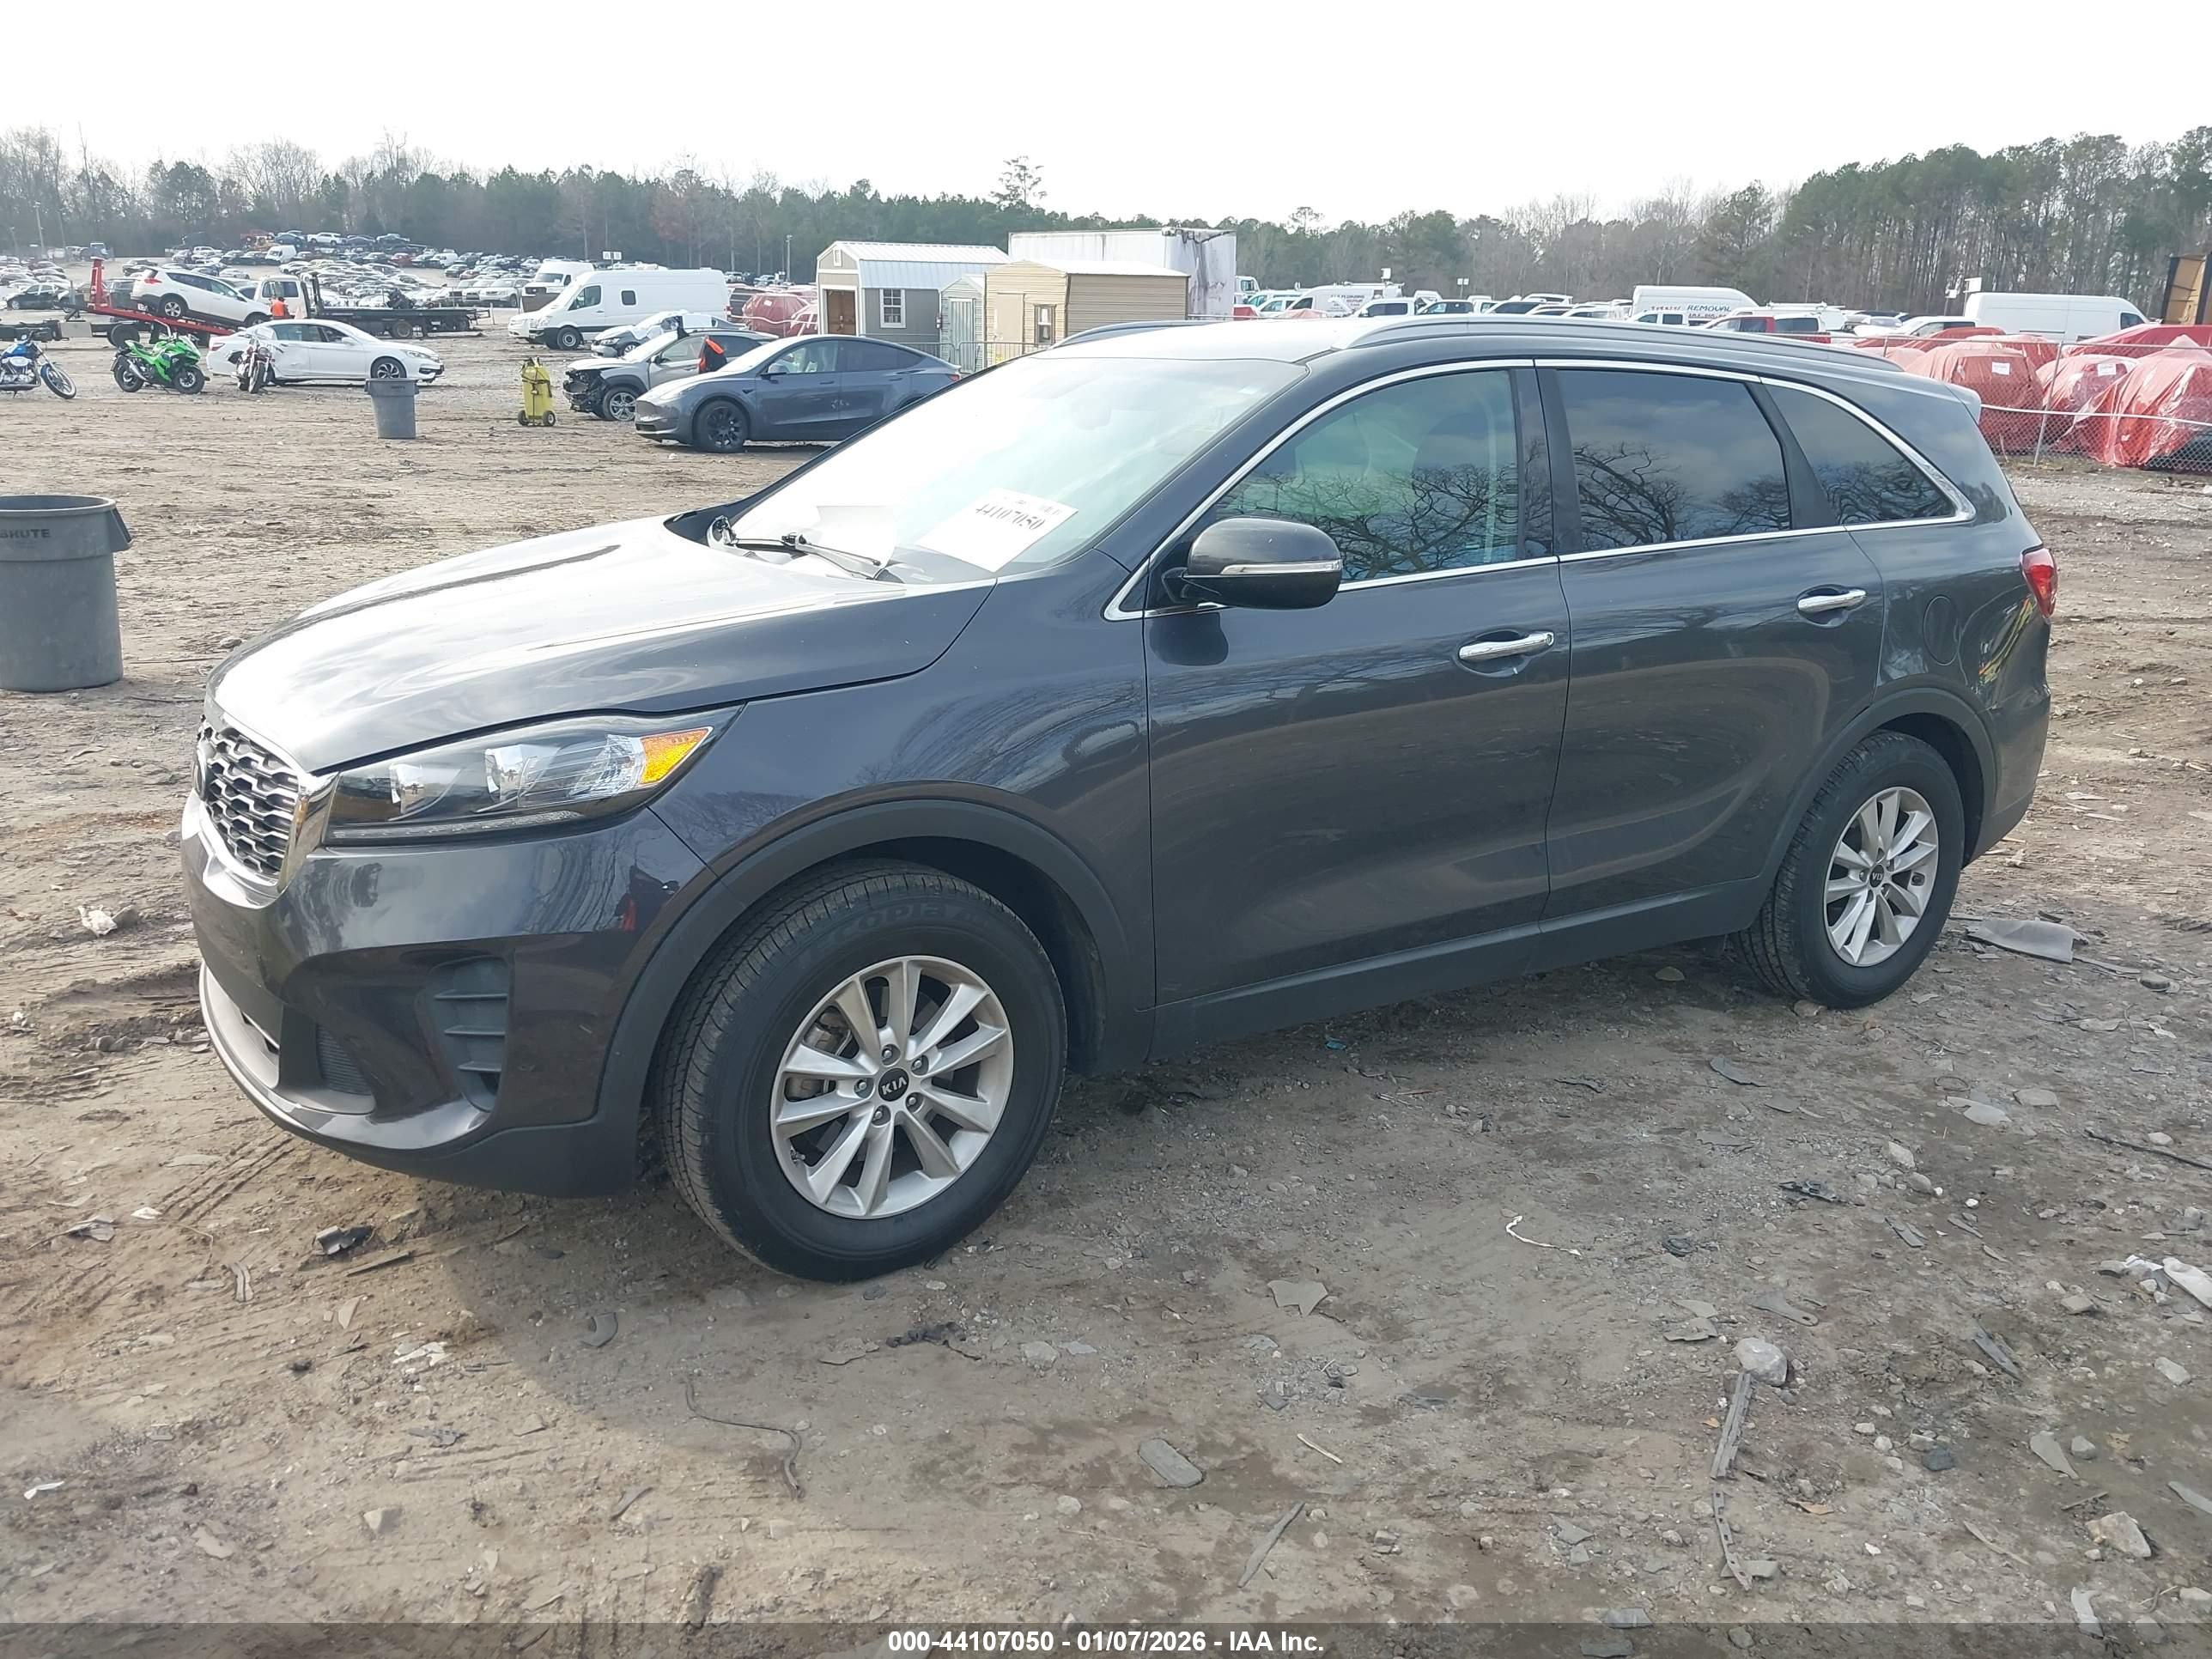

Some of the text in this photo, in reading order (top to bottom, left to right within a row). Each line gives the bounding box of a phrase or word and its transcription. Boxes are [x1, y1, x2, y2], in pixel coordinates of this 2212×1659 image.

[1686, 304, 1732, 313] REMOVAL
[975, 503, 1047, 530] 44107050
[881, 1076, 908, 1096] KIA
